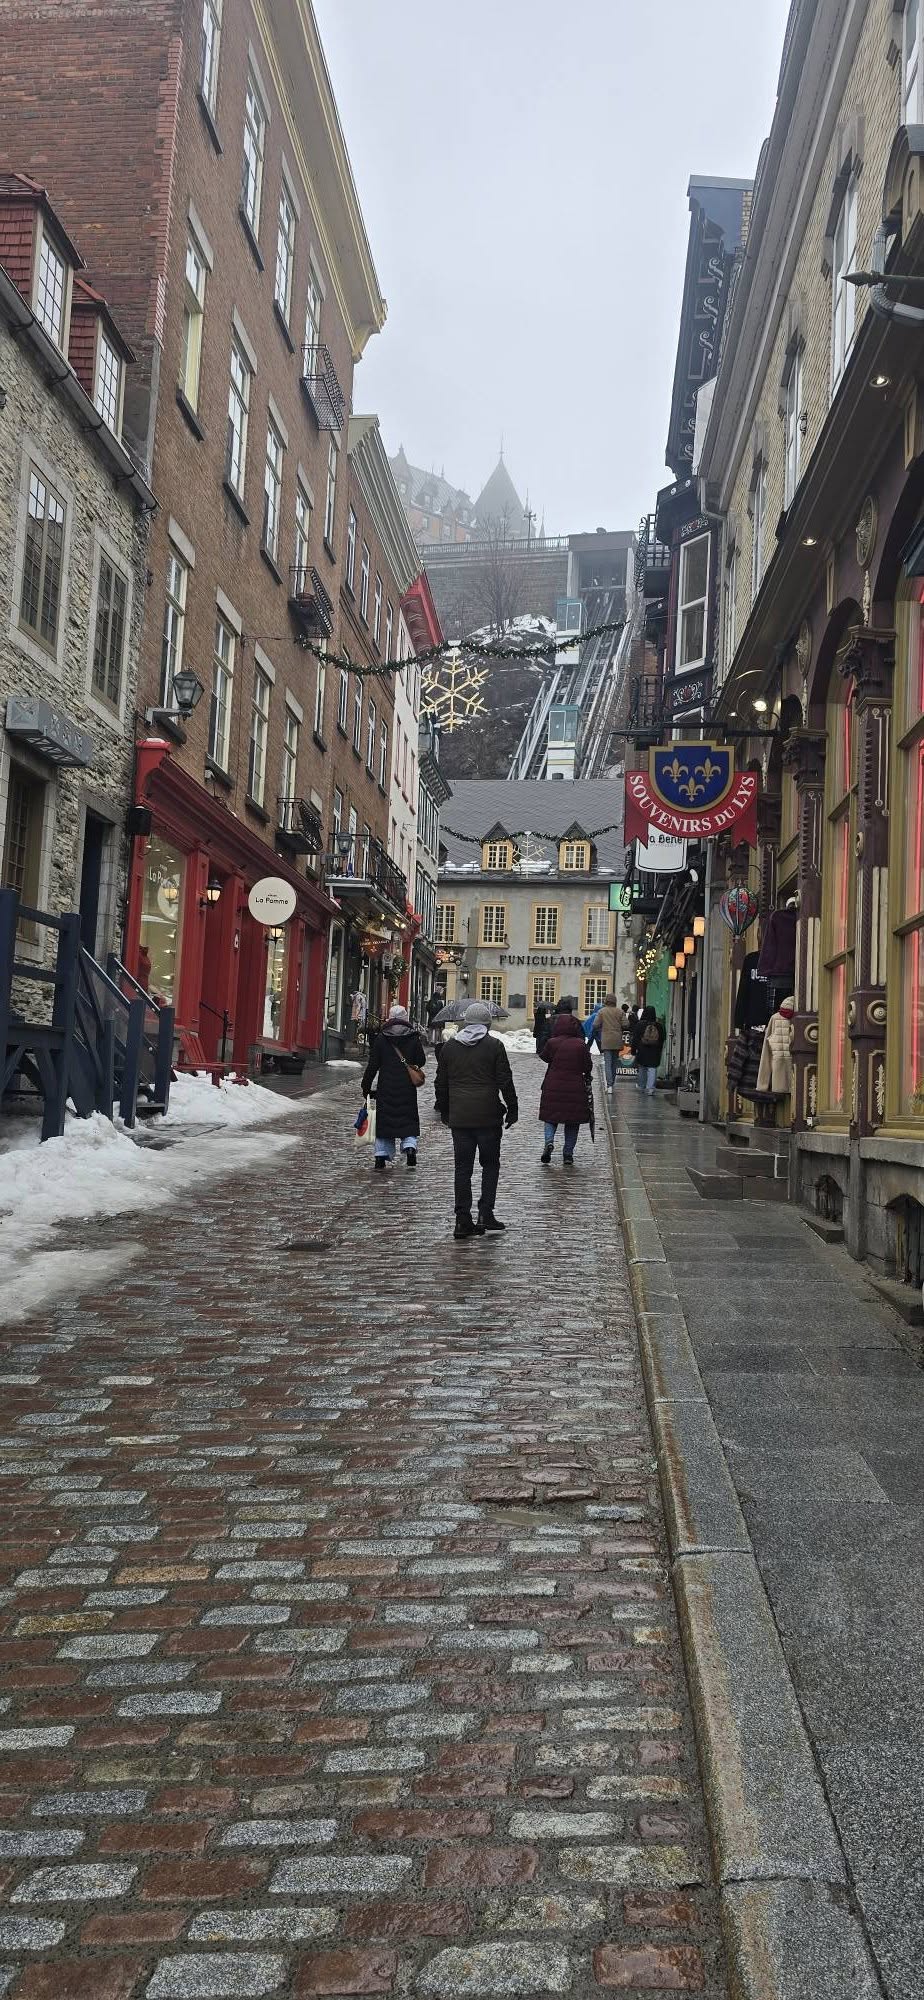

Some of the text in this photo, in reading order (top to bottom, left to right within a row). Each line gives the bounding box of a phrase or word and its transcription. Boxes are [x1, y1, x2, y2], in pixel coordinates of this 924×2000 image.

[629, 775, 755, 833] SOUVENIRS DU LYS
[499, 954, 591, 967] FUNICULAIRE
[615, 1067, 638, 1075] UVENIRS
